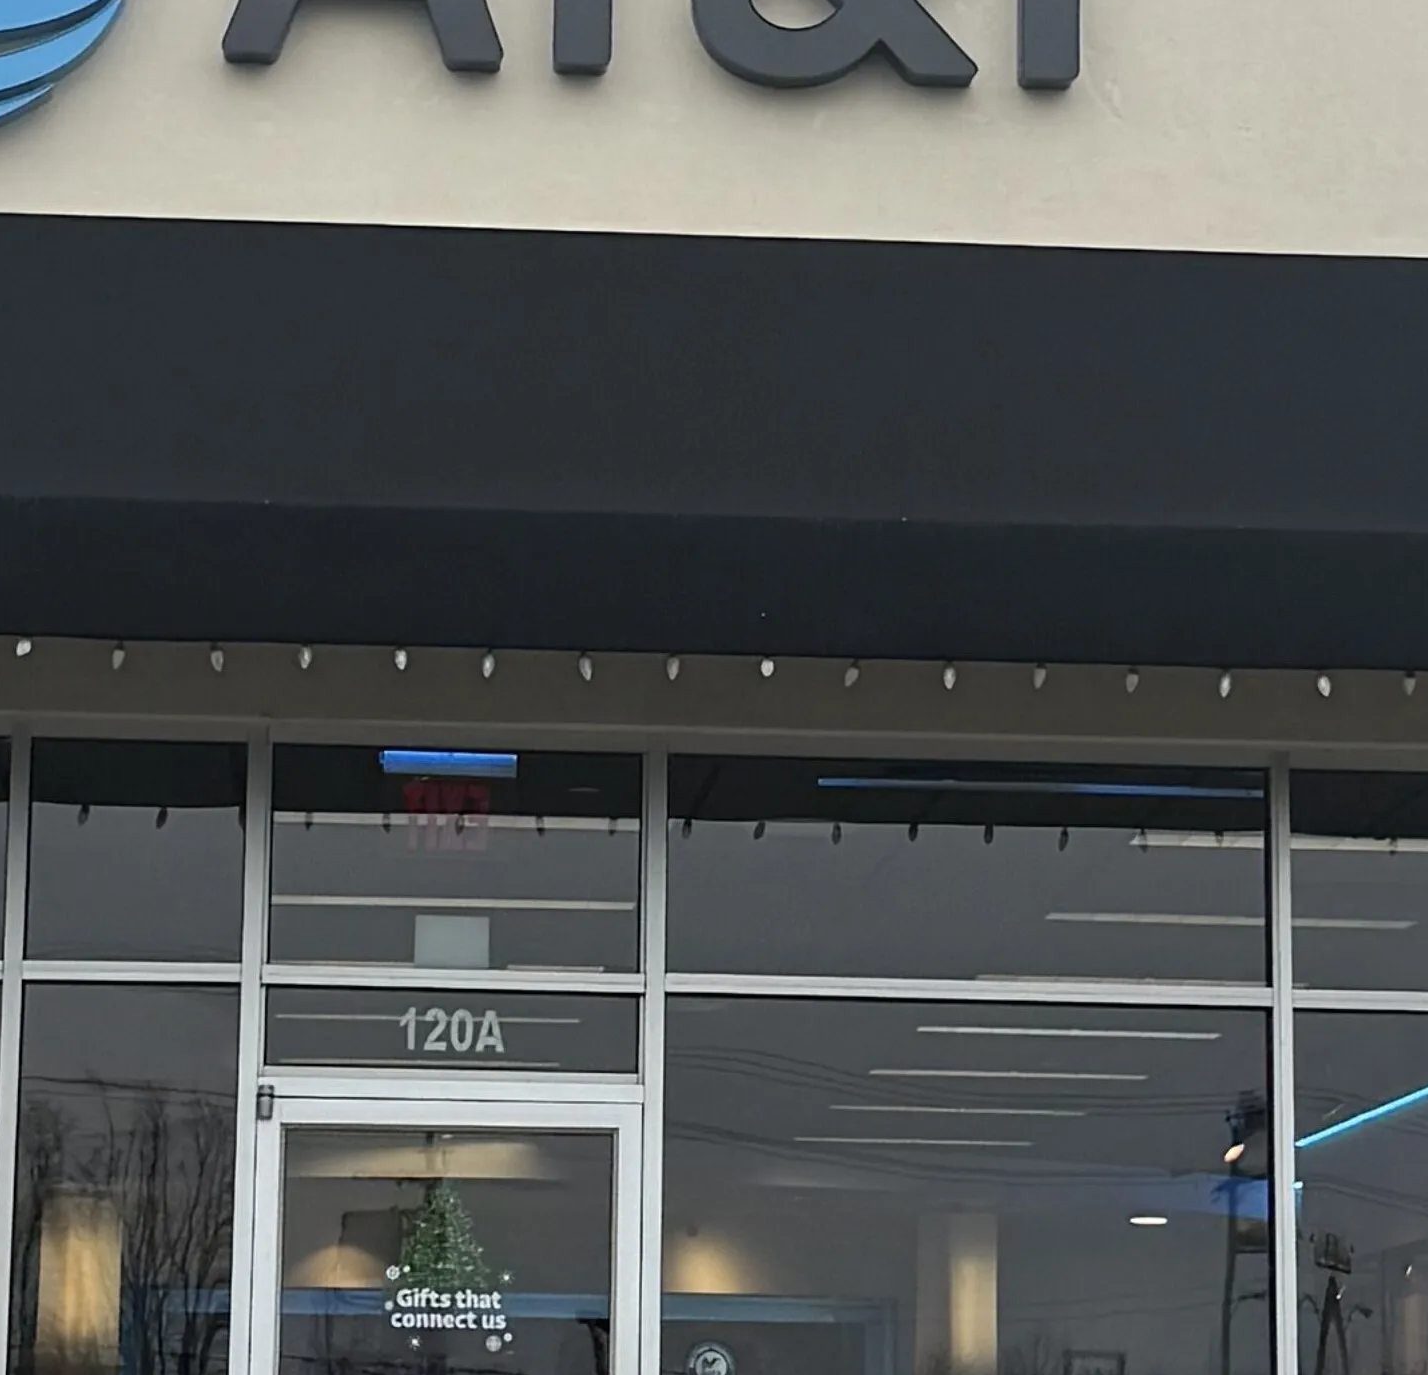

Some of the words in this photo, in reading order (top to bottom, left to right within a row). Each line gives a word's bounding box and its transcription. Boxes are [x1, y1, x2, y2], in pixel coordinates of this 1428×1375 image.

[399, 1006, 505, 1053] 120A
[395, 1287, 452, 1309] Gifts
[454, 1289, 503, 1311] that
[390, 1310, 478, 1330] connect
[481, 1313, 508, 1331] us
